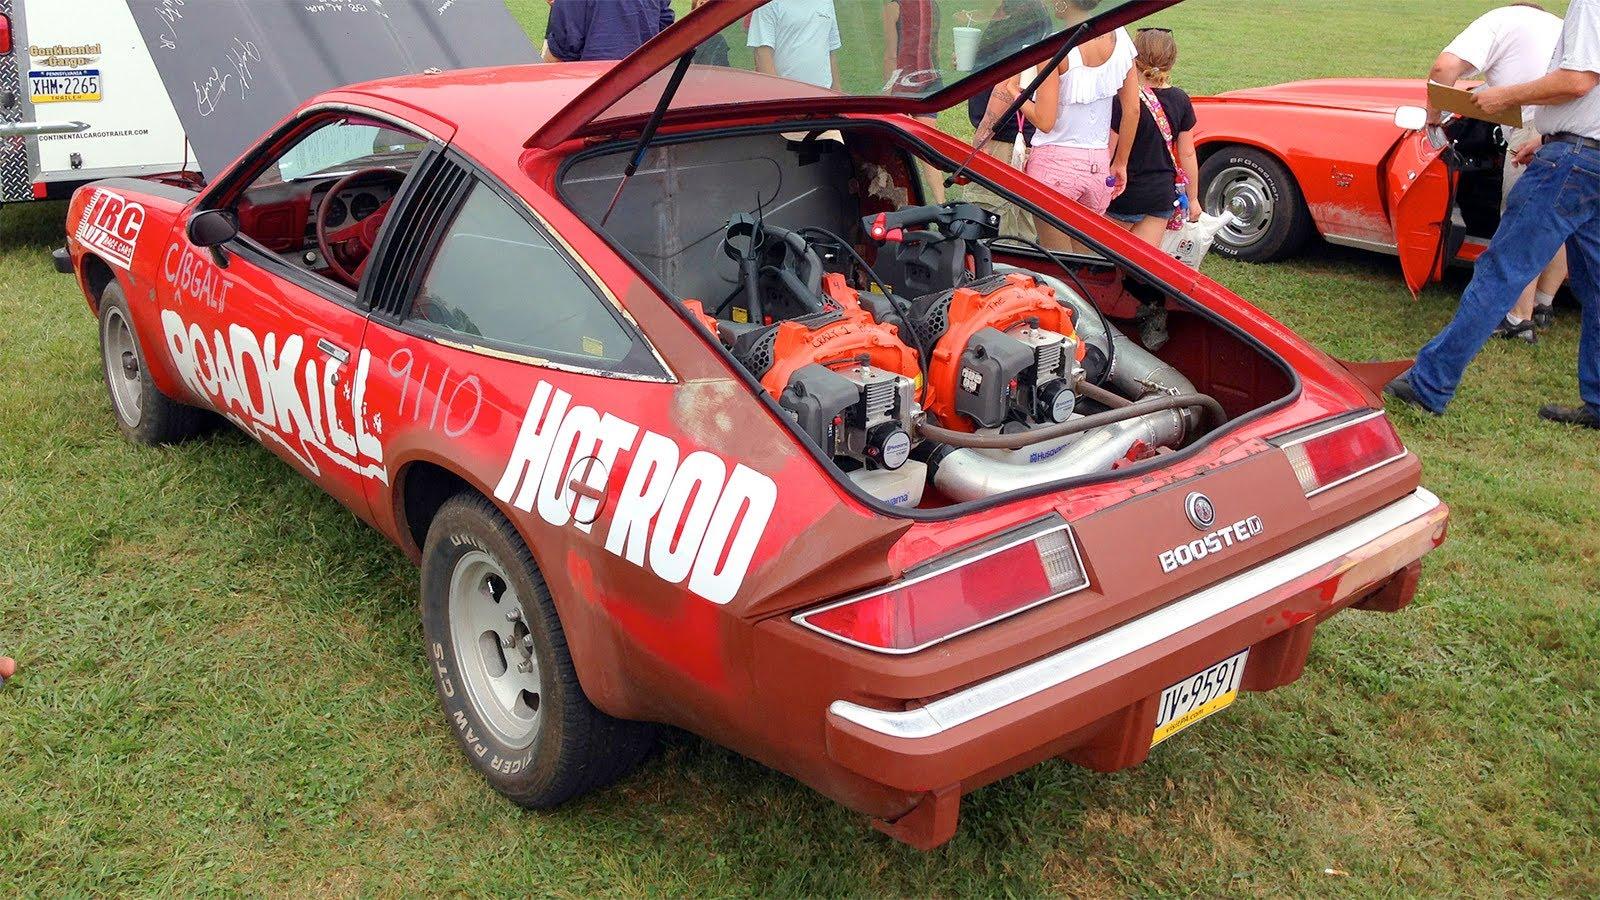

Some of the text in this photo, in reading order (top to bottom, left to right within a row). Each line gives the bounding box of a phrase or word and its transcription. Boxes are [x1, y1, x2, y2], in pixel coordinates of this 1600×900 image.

[29, 43, 102, 56] Continental
[47, 56, 85, 68] Cargo
[39, 129, 149, 141] CONTINENTALCARGOTRAILER.COM
[1230, 157, 1280, 202] BFGoodrich
[161, 309, 384, 464] ROADKILL
[387, 347, 484, 438] 9110
[494, 380, 778, 605] HOT ROD
[1158, 514, 1264, 573] BOOSTED
[453, 709, 489, 758] PAW
